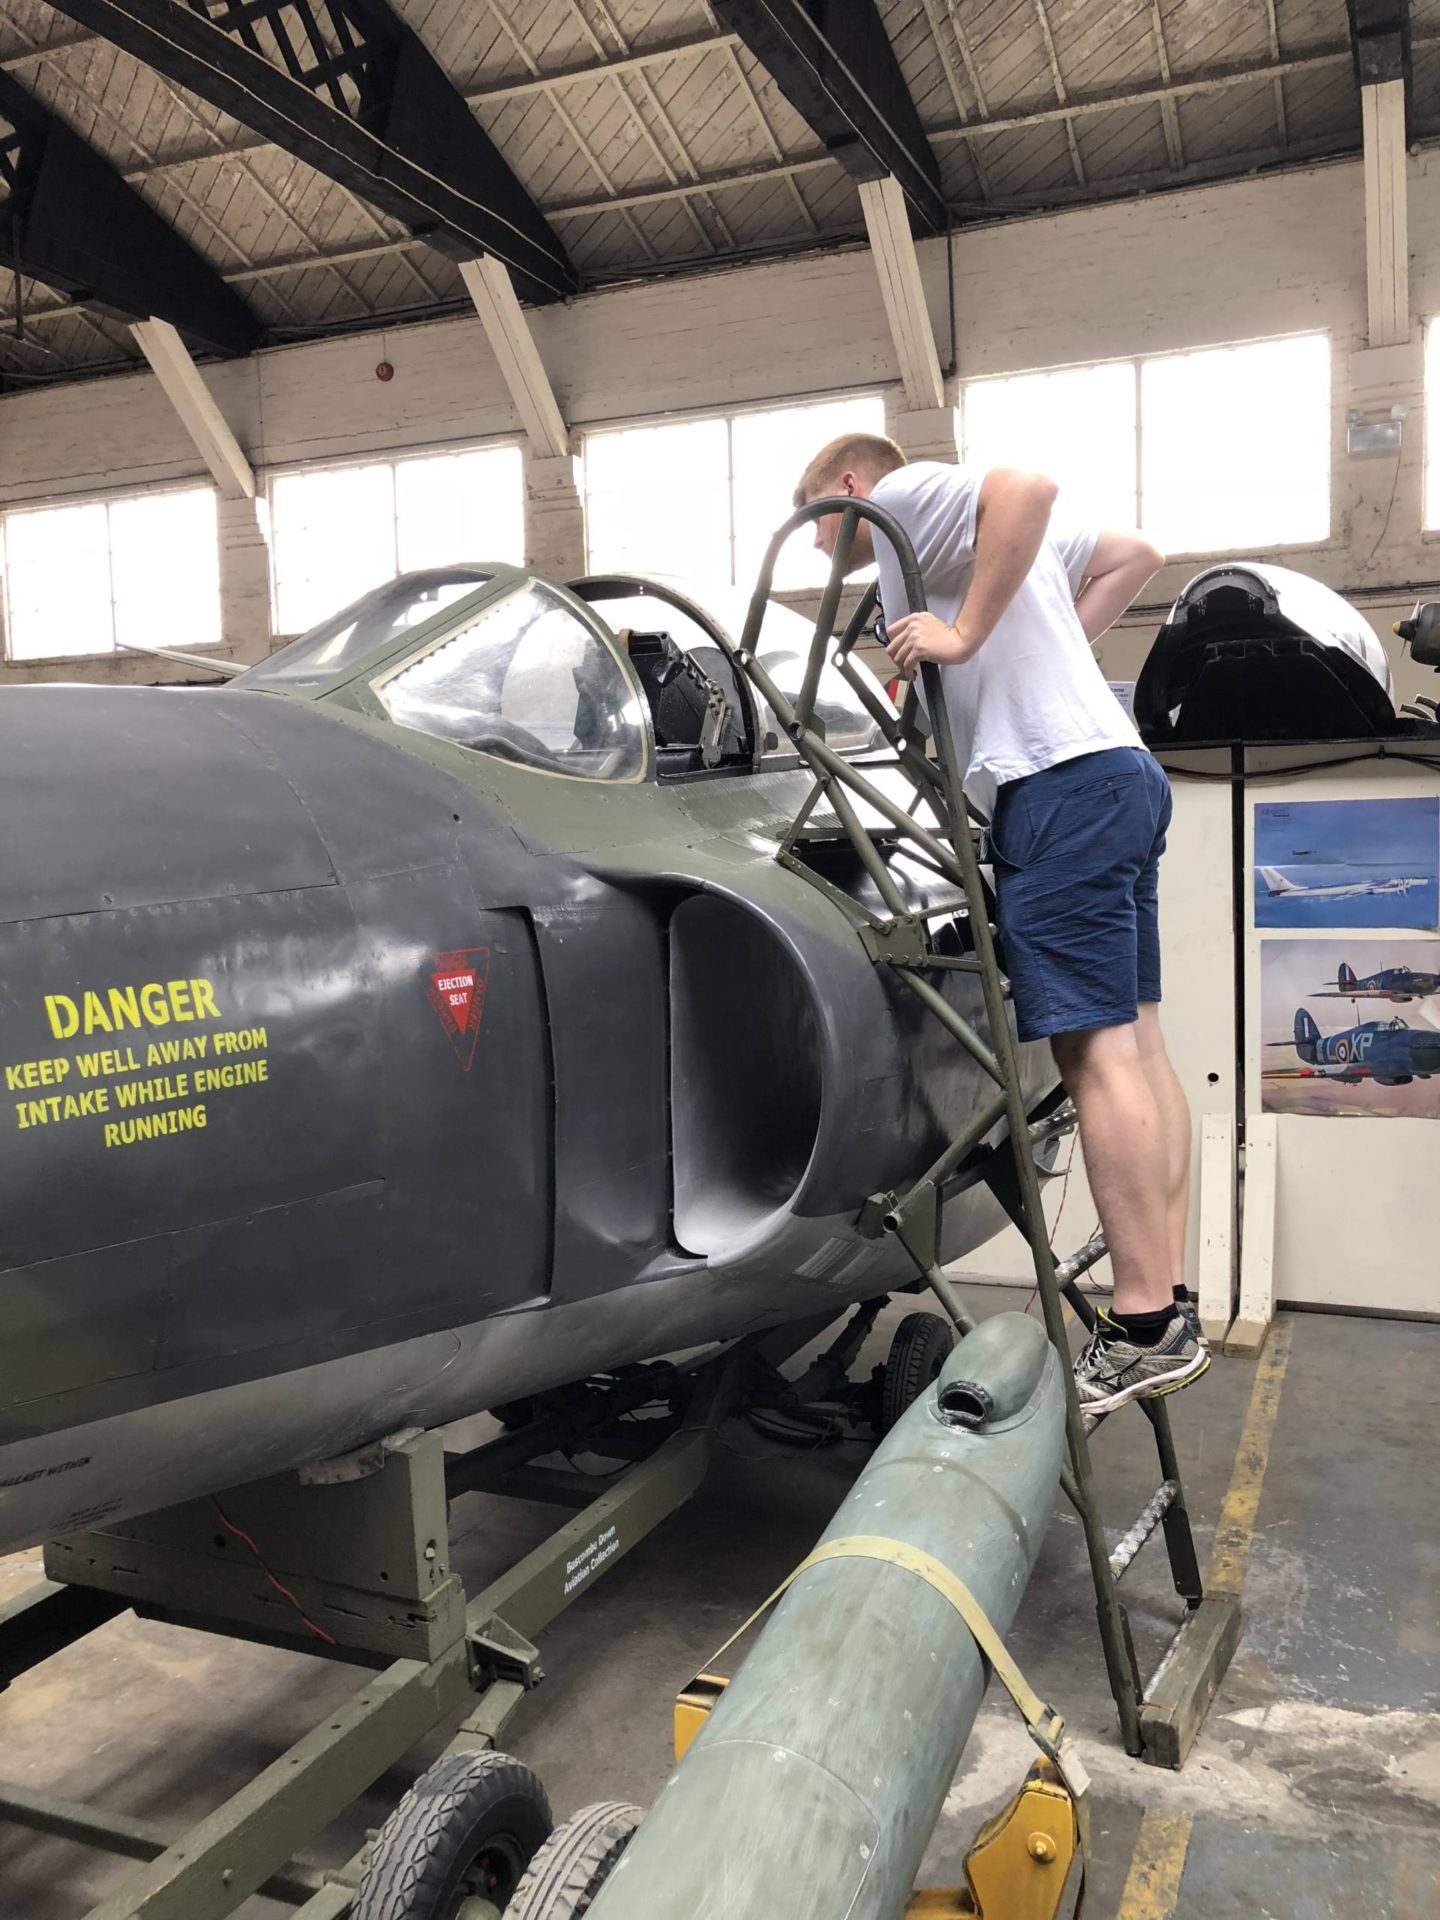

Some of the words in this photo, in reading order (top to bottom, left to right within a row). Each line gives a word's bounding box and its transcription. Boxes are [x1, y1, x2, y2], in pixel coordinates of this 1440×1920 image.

[438, 975, 474, 991] EJECTION
[449, 992, 468, 1006] SEAT
[44, 978, 222, 1040] DANGER
[5, 1057, 70, 1091] KEEP
[75, 1047, 141, 1079] WELL
[146, 1035, 208, 1067] AWAY
[213, 1027, 269, 1055] FROM
[1326, 1036, 1337, 1061] L
[1350, 1032, 1374, 1061] XP
[15, 1088, 110, 1130] INTAKE
[115, 1073, 189, 1109] WHILE
[194, 1059, 269, 1094] ENGINE
[104, 1105, 207, 1148] RUNNING
[47, 1456, 94, 1476] WITHIN
[564, 1565, 590, 1594] Aviation
[590, 1539, 620, 1571] Collection
[566, 1540, 597, 1574] Boscombe
[598, 1525, 616, 1545] Down
